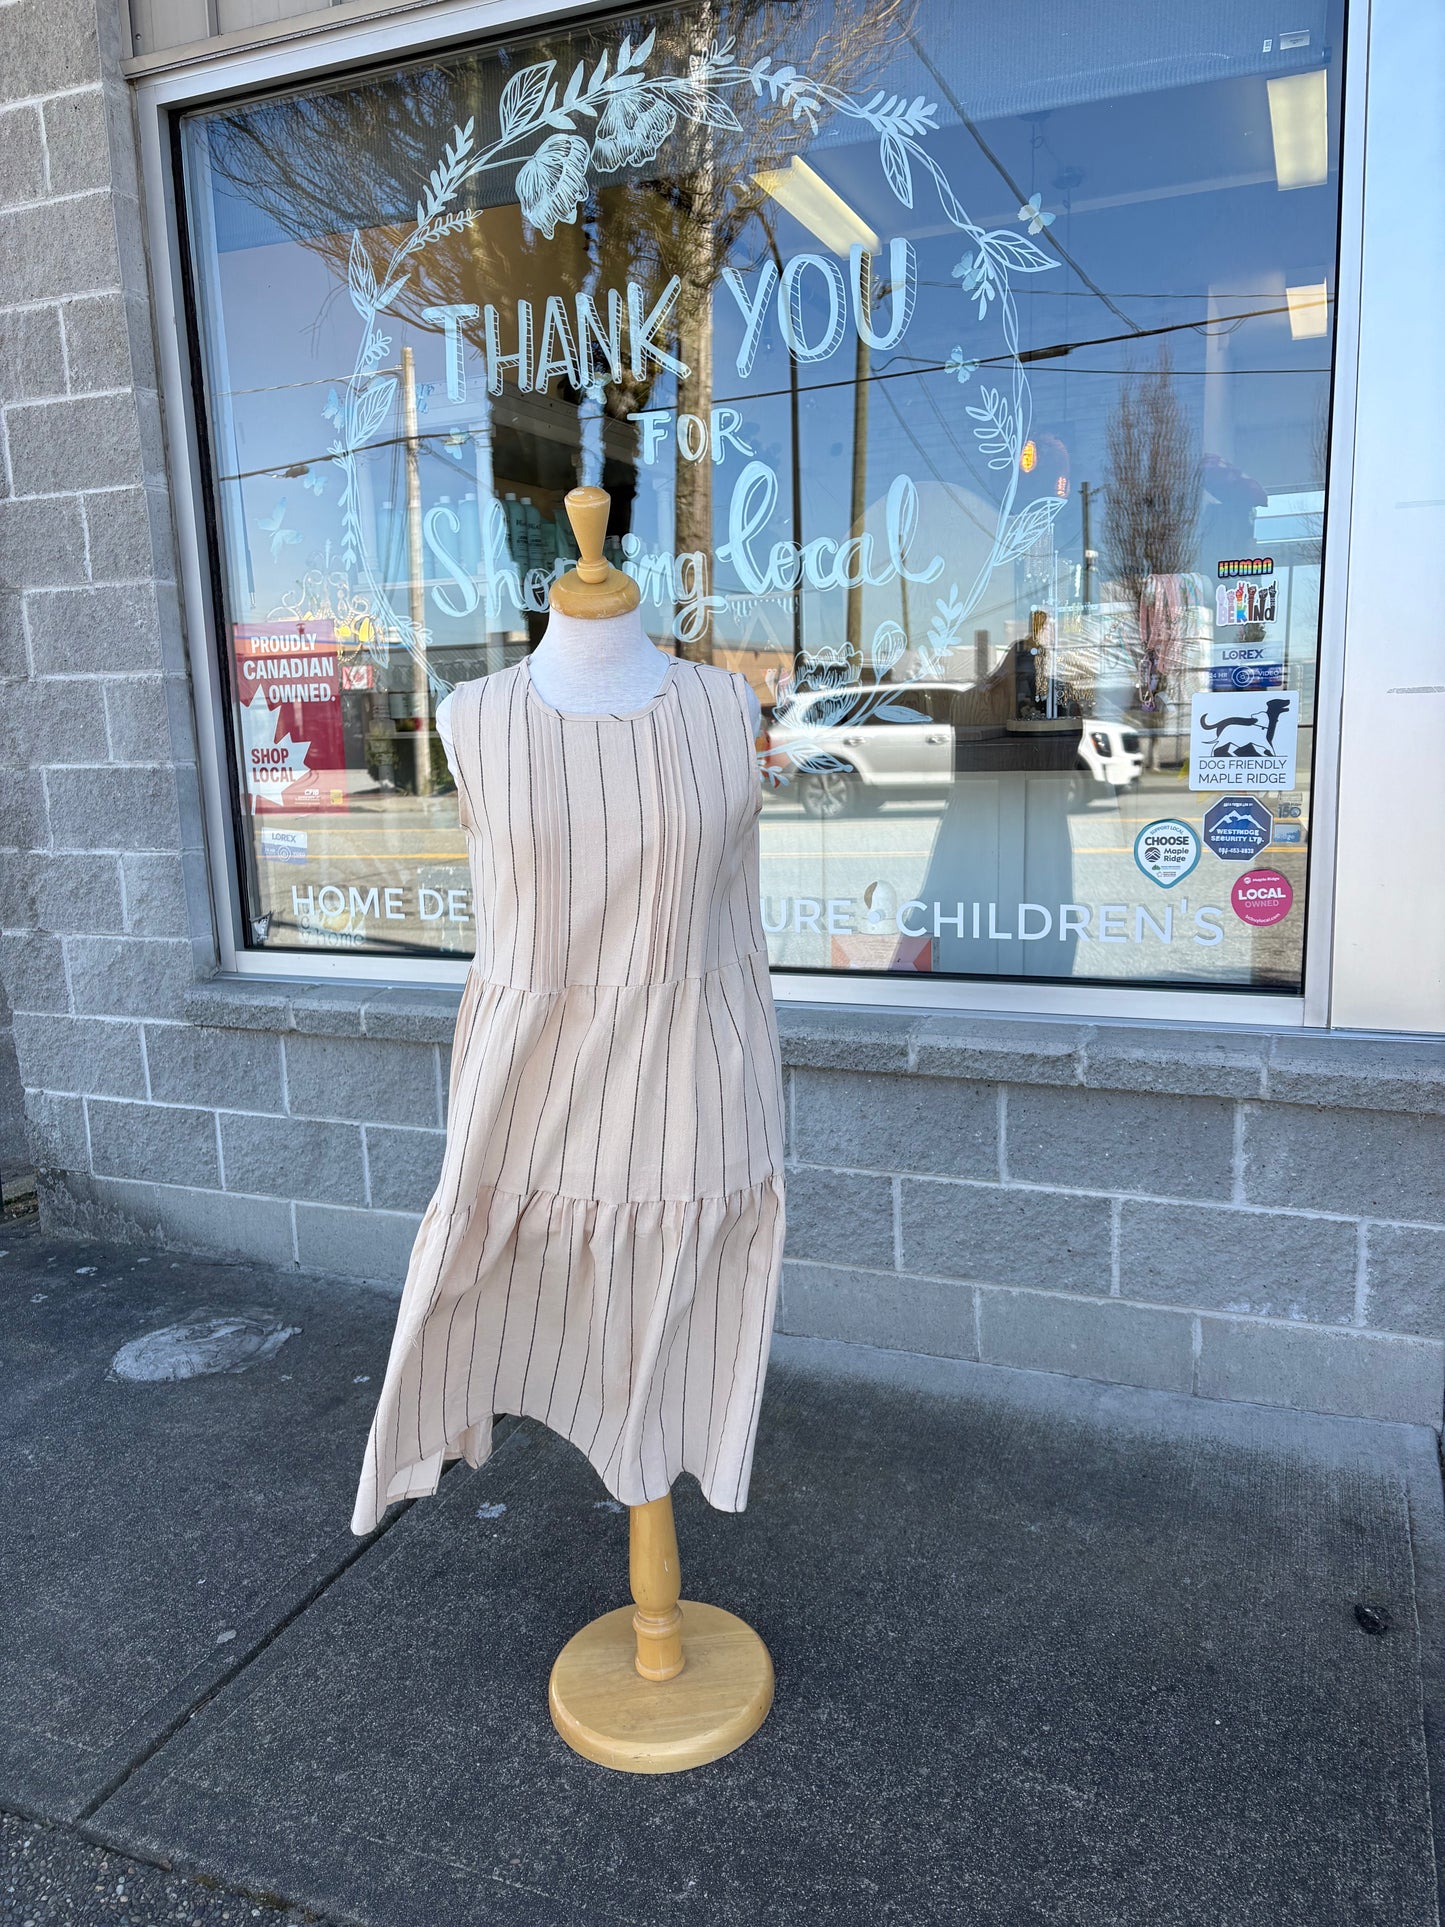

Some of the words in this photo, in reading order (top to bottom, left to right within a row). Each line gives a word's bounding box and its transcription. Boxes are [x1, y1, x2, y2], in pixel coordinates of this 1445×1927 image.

[421, 275, 692, 403] THANK
[722, 238, 917, 378] YOU
[627, 408, 757, 465] FOR
[423, 497, 728, 643] Shoing
[715, 461, 944, 597] local
[250, 633, 317, 654] PROUDLY
[1222, 648, 1265, 660] LOREX
[243, 656, 334, 680] CANADIAN
[268, 683, 336, 704] OWNED.
[251, 747, 289, 764] SHOP
[1199, 759, 1226, 770] DOG
[1228, 759, 1288, 770] FRIENDLY
[252, 767, 296, 783] LOCAL
[1198, 773, 1243, 784] MAPLE
[1246, 773, 1287, 784] RIDGE
[271, 832, 297, 844] LOREX
[1144, 836, 1190, 846] CHOOSE
[1210, 835, 1248, 843] SECURITY
[1163, 847, 1190, 856] Maple
[1163, 855, 1186, 863] Ridge
[1238, 887, 1287, 901] LOCAL
[1244, 899, 1280, 908] OWNED
[291, 885, 406, 920] HOME
[418, 888, 474, 922] DE
[759, 898, 853, 935] URE
[896, 896, 1225, 947] CHILDREN'S
